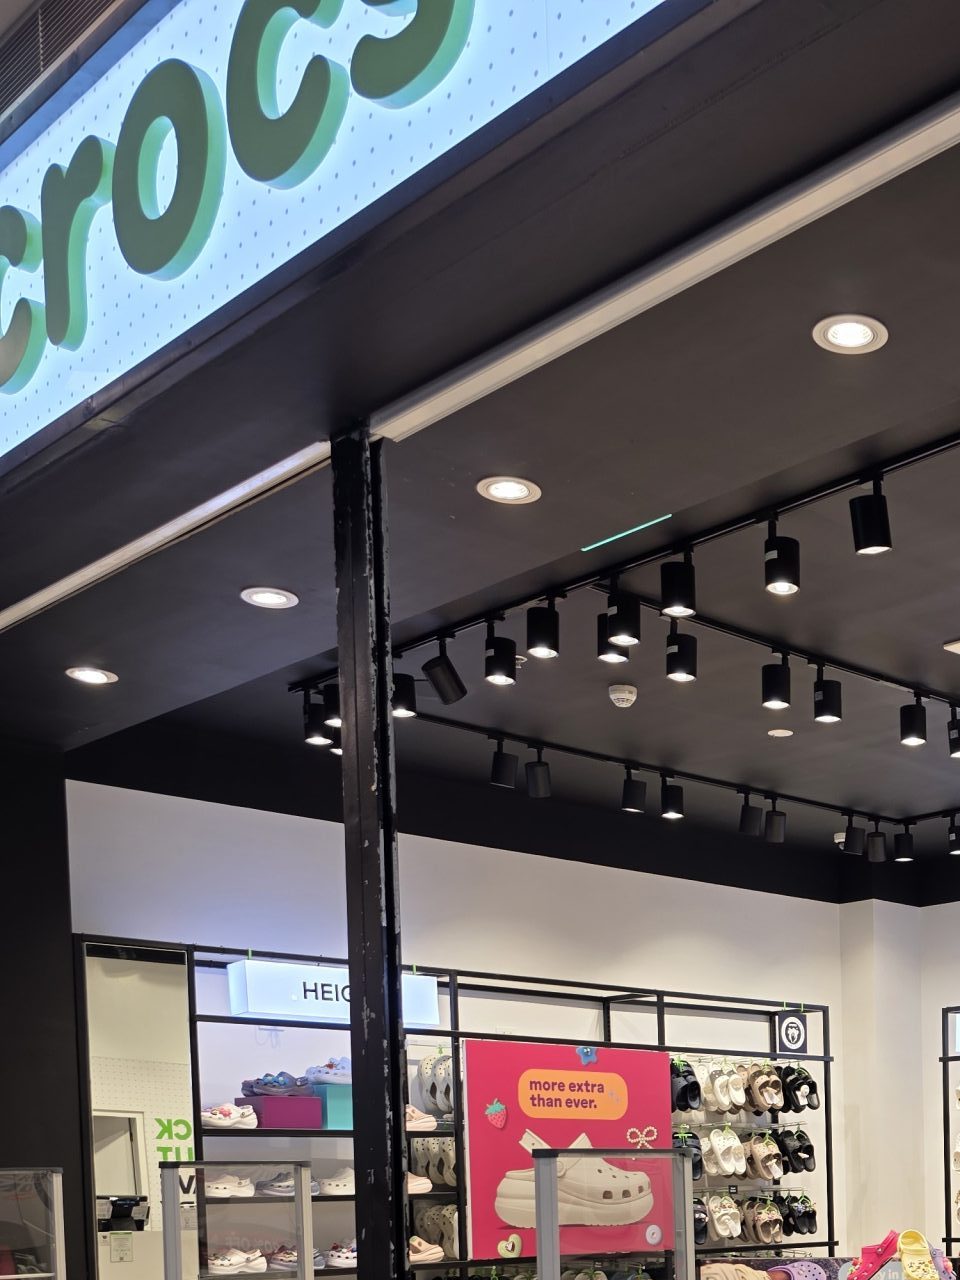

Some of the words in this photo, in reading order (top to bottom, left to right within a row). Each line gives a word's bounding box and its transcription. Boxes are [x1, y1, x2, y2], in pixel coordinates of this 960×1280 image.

[529, 1080, 565, 1092] more
[569, 1080, 604, 1093] extra
[530, 1094, 562, 1108] than
[565, 1097, 597, 1109] ever.
